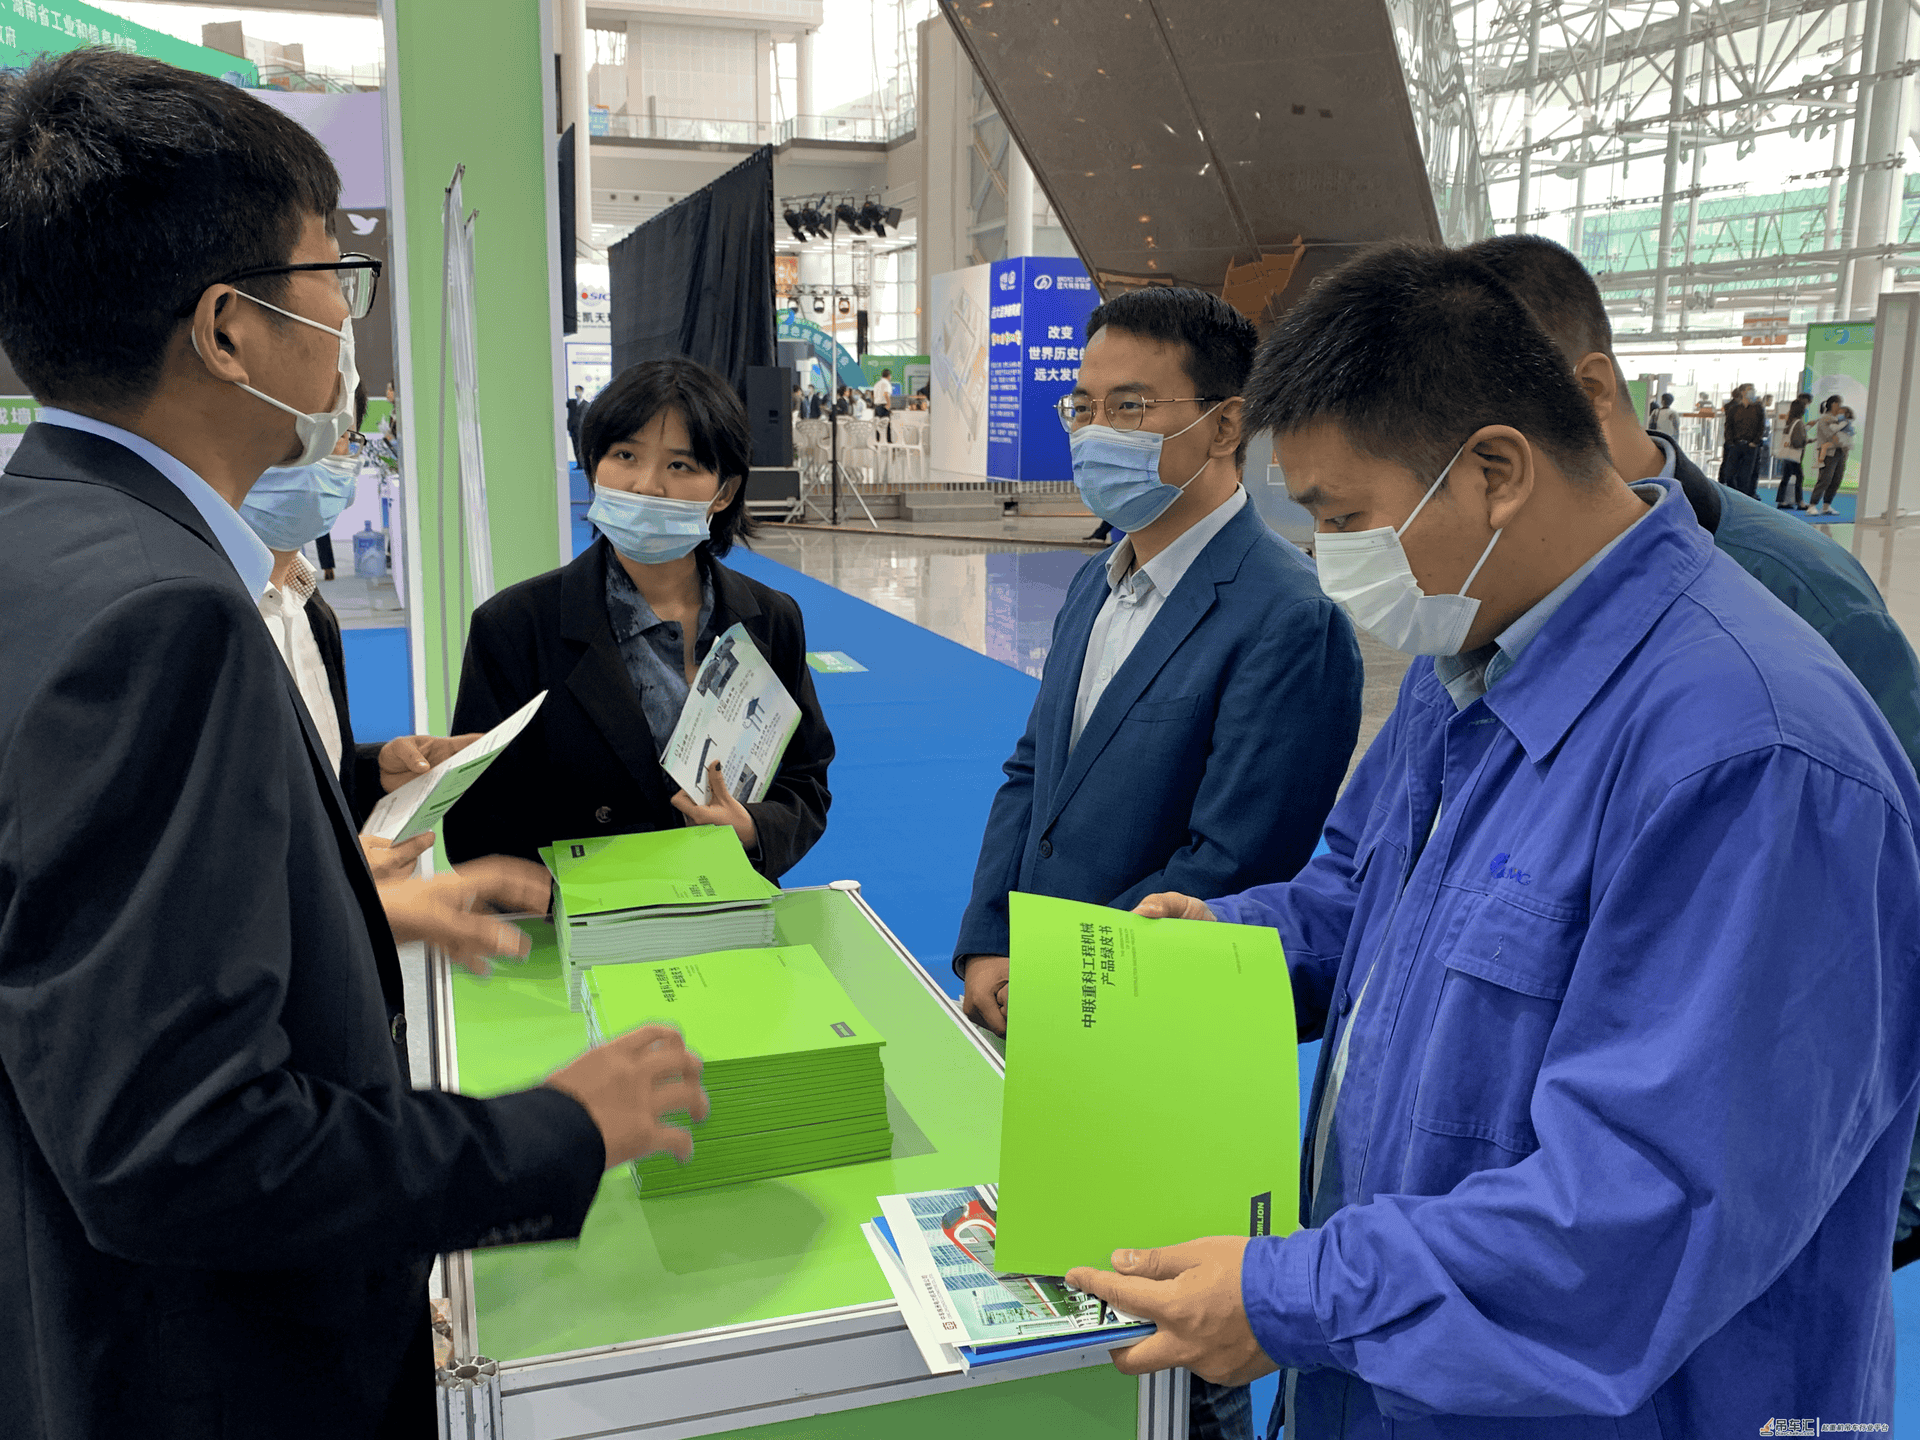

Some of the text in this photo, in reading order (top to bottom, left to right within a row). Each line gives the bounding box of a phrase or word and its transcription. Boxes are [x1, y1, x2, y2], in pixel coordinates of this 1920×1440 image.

[1047, 325, 1074, 340] 改变
[1080, 923, 1097, 1029] 中联重科工程机械
[1099, 925, 1116, 987] 产品绿皮书
